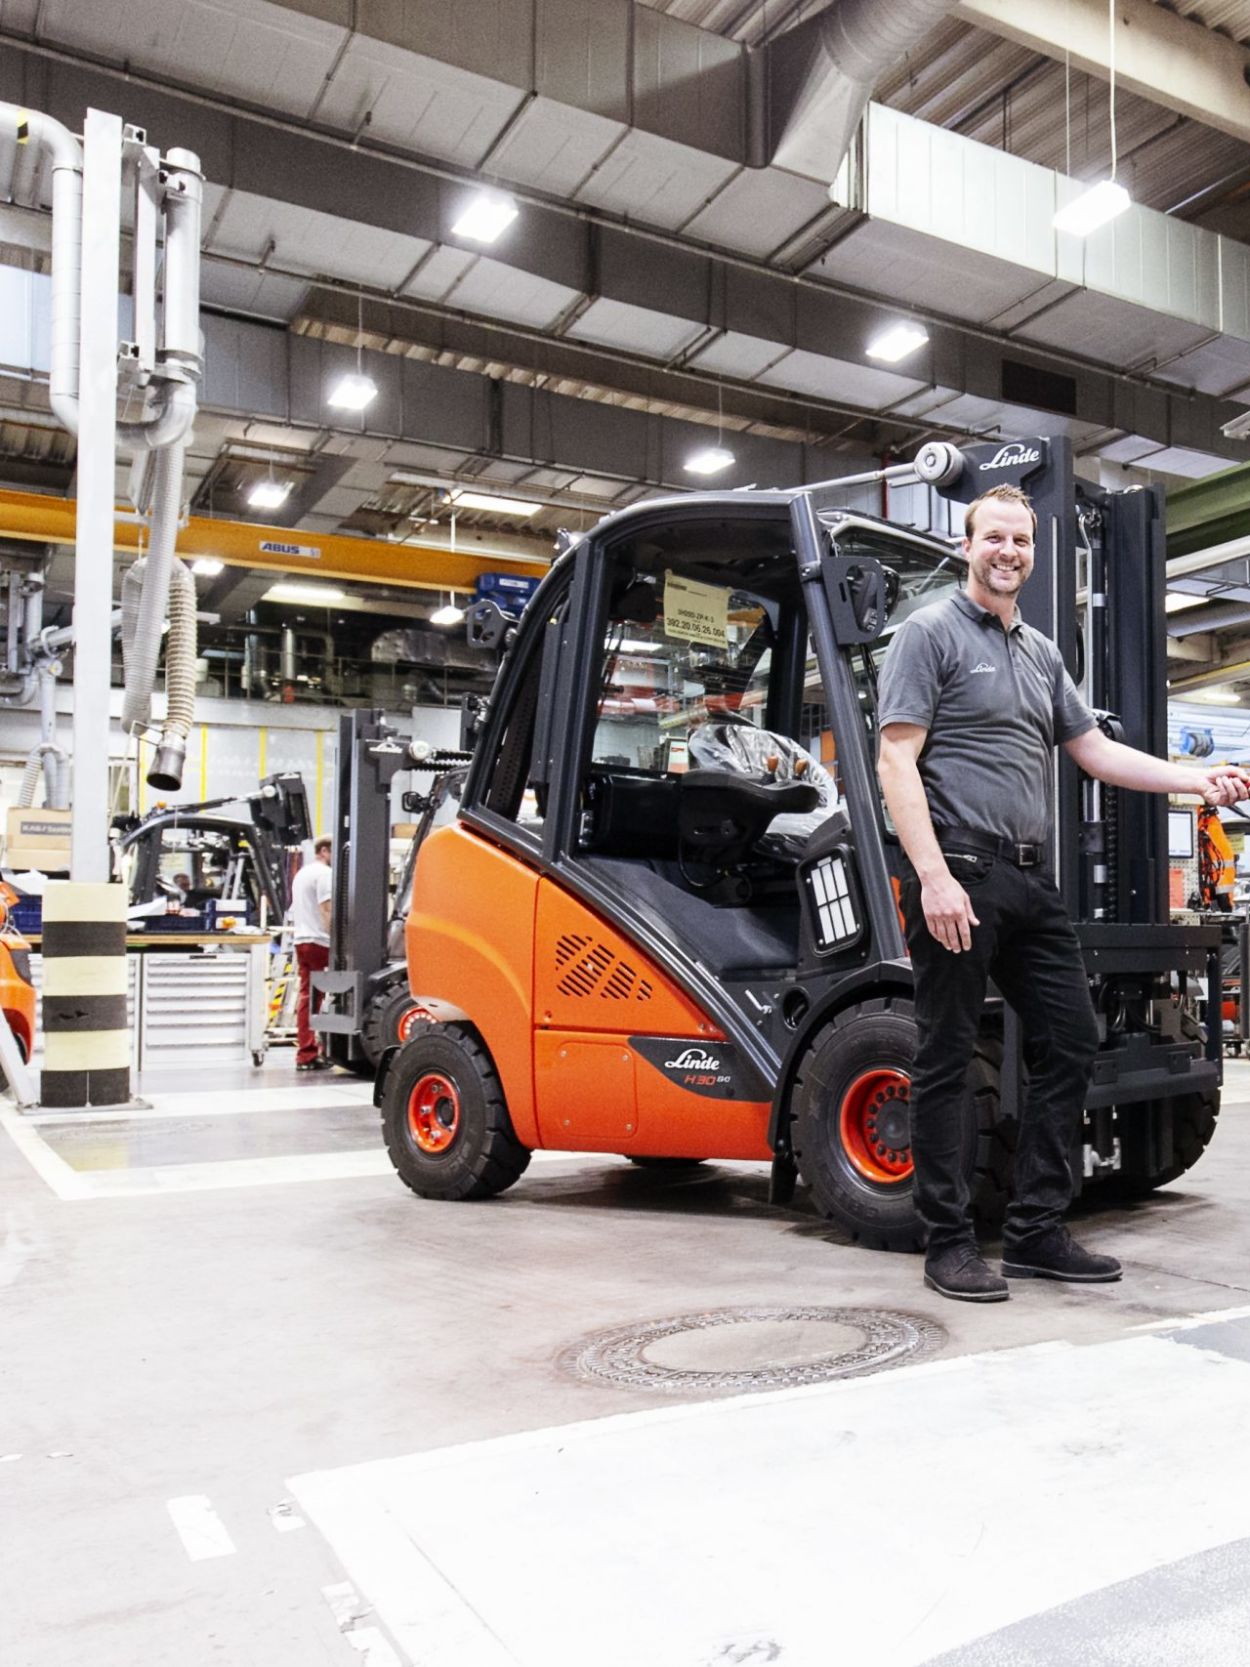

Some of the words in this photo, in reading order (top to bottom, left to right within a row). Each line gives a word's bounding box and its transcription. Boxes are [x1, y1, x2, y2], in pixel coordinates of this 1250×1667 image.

[979, 443, 1040, 471] Linde
[262, 542, 300, 554] ABUS
[969, 662, 997, 674] Linde
[664, 1048, 721, 1071] Linde
